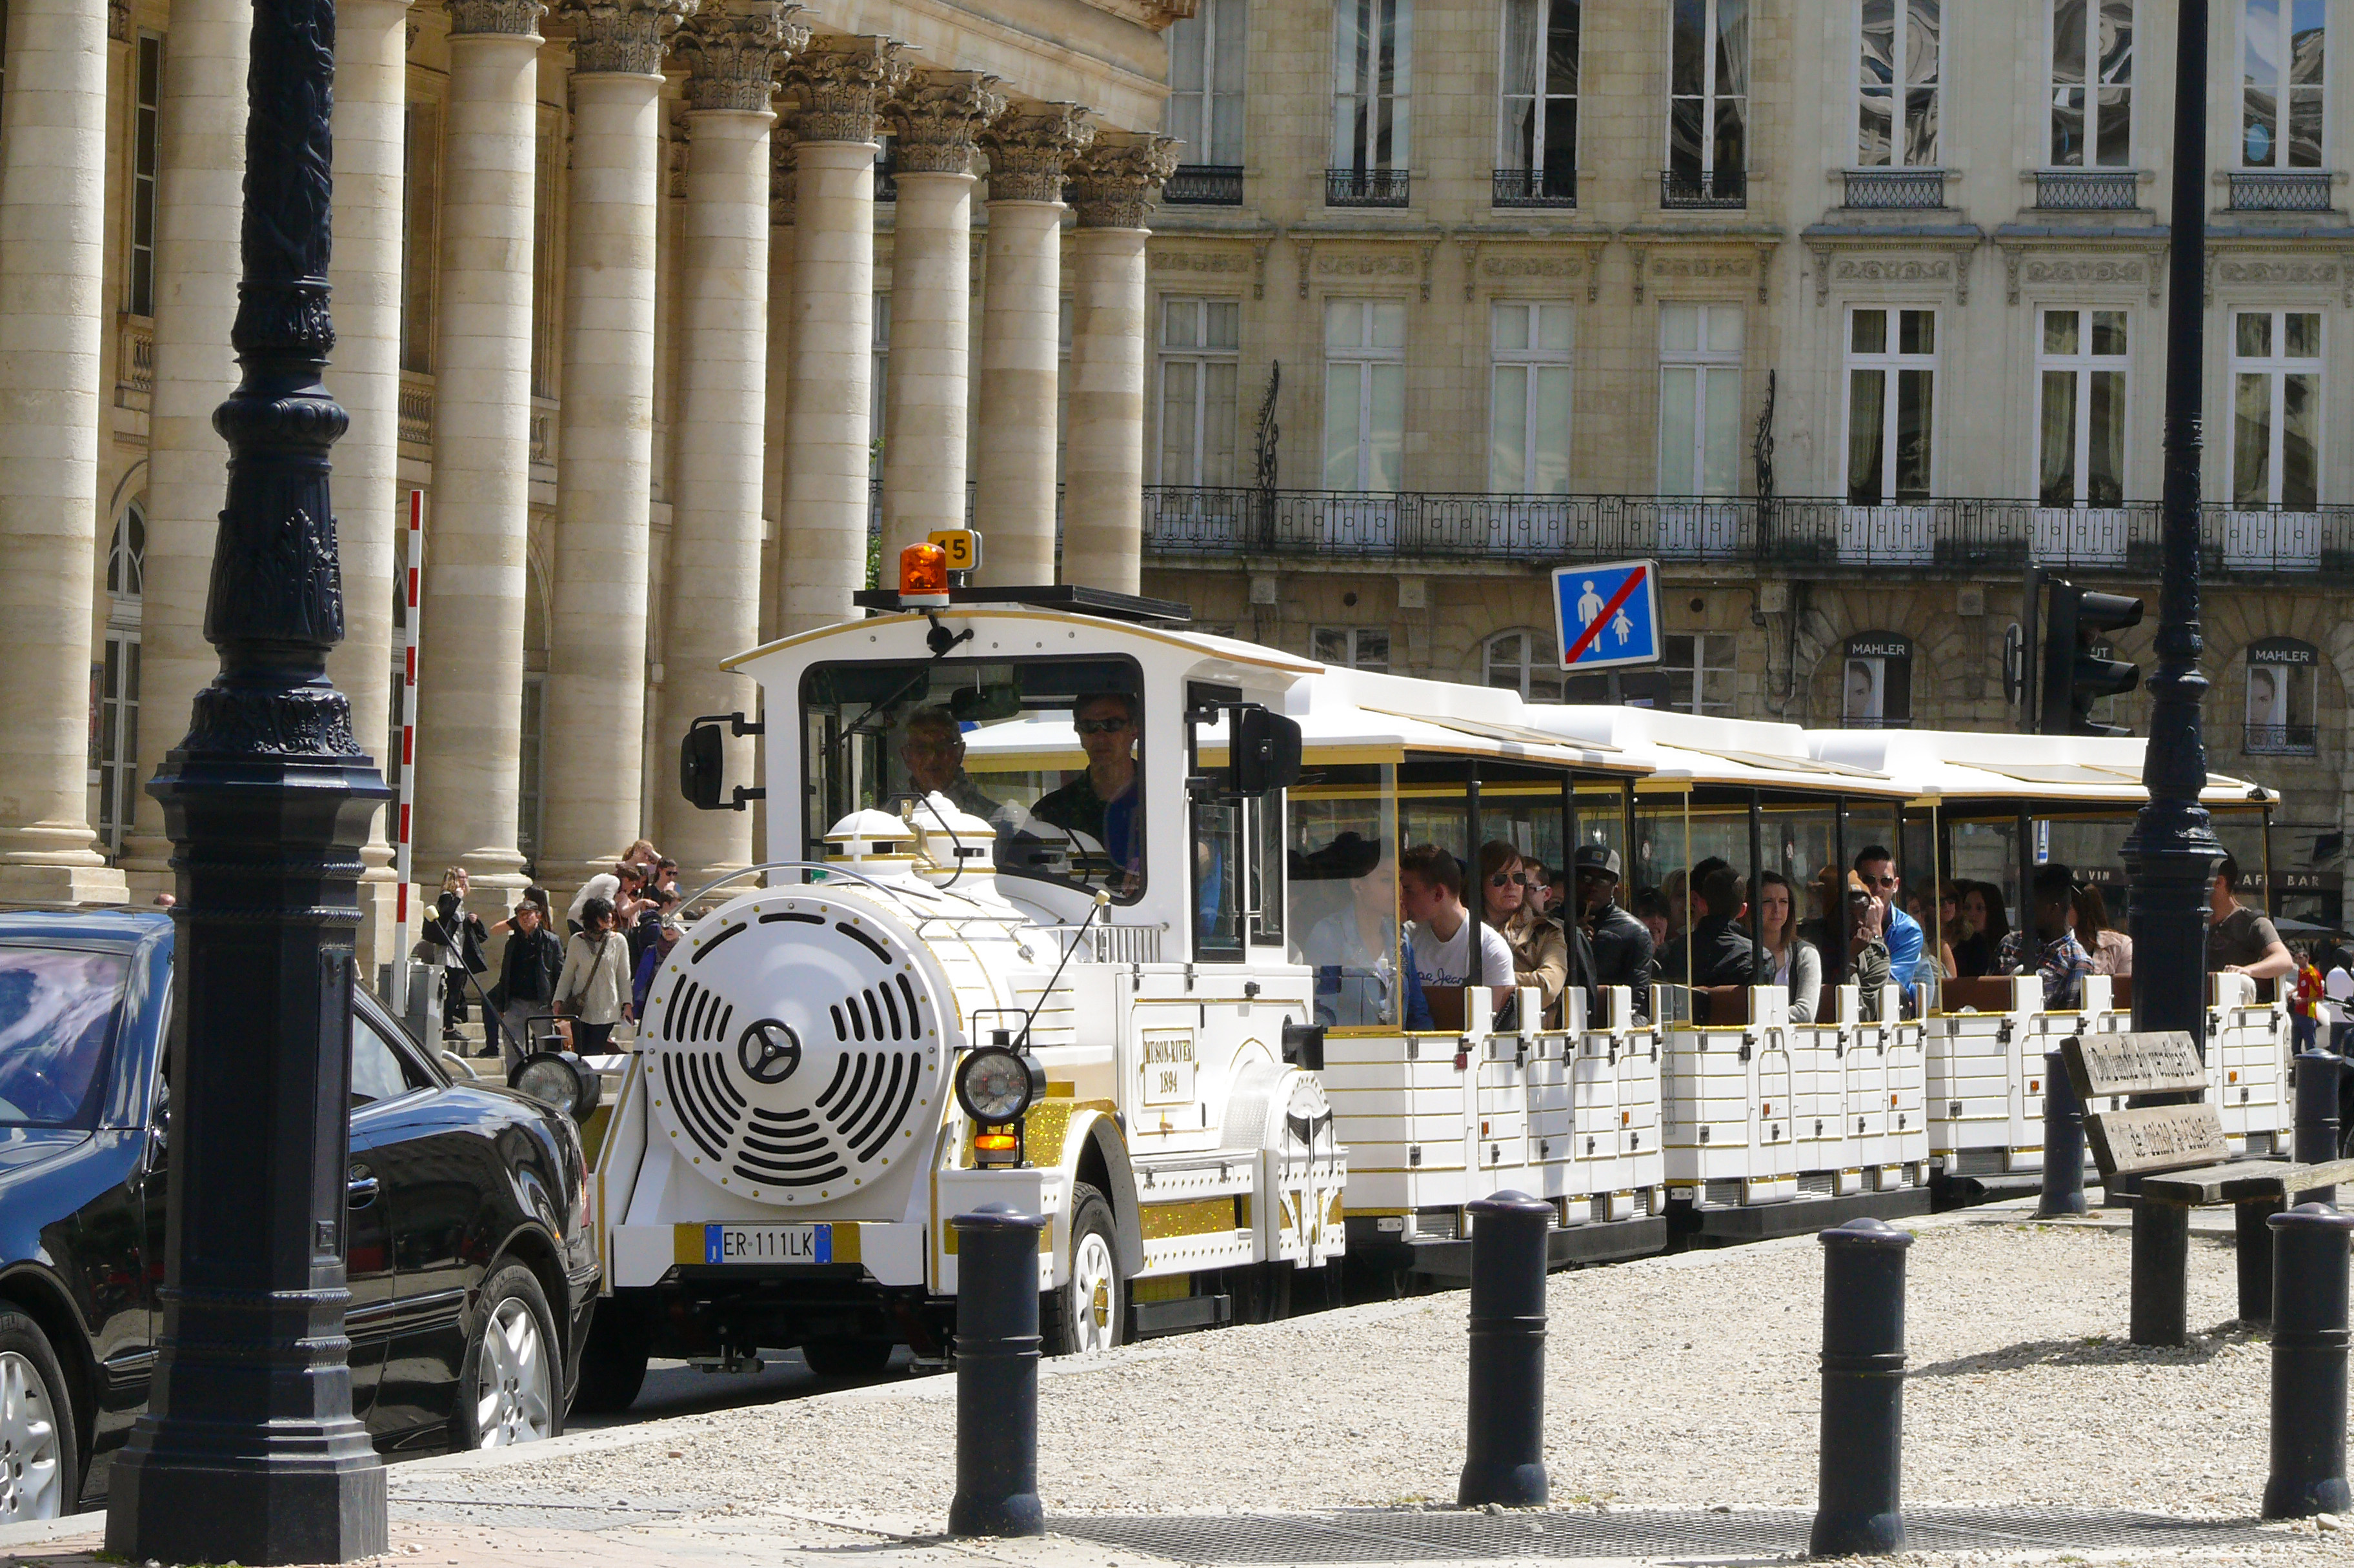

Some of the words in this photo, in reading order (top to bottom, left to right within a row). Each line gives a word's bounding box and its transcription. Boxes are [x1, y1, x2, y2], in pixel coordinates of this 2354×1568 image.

[1852, 644, 1905, 655] MAHLER
[2255, 650, 2309, 662] MAHLER
[2088, 870, 2110, 881] VIN
[2287, 874, 2319, 887] BAR
[2148, 1041, 2195, 1078] vendredi
[1160, 1070, 1178, 1094] 1894
